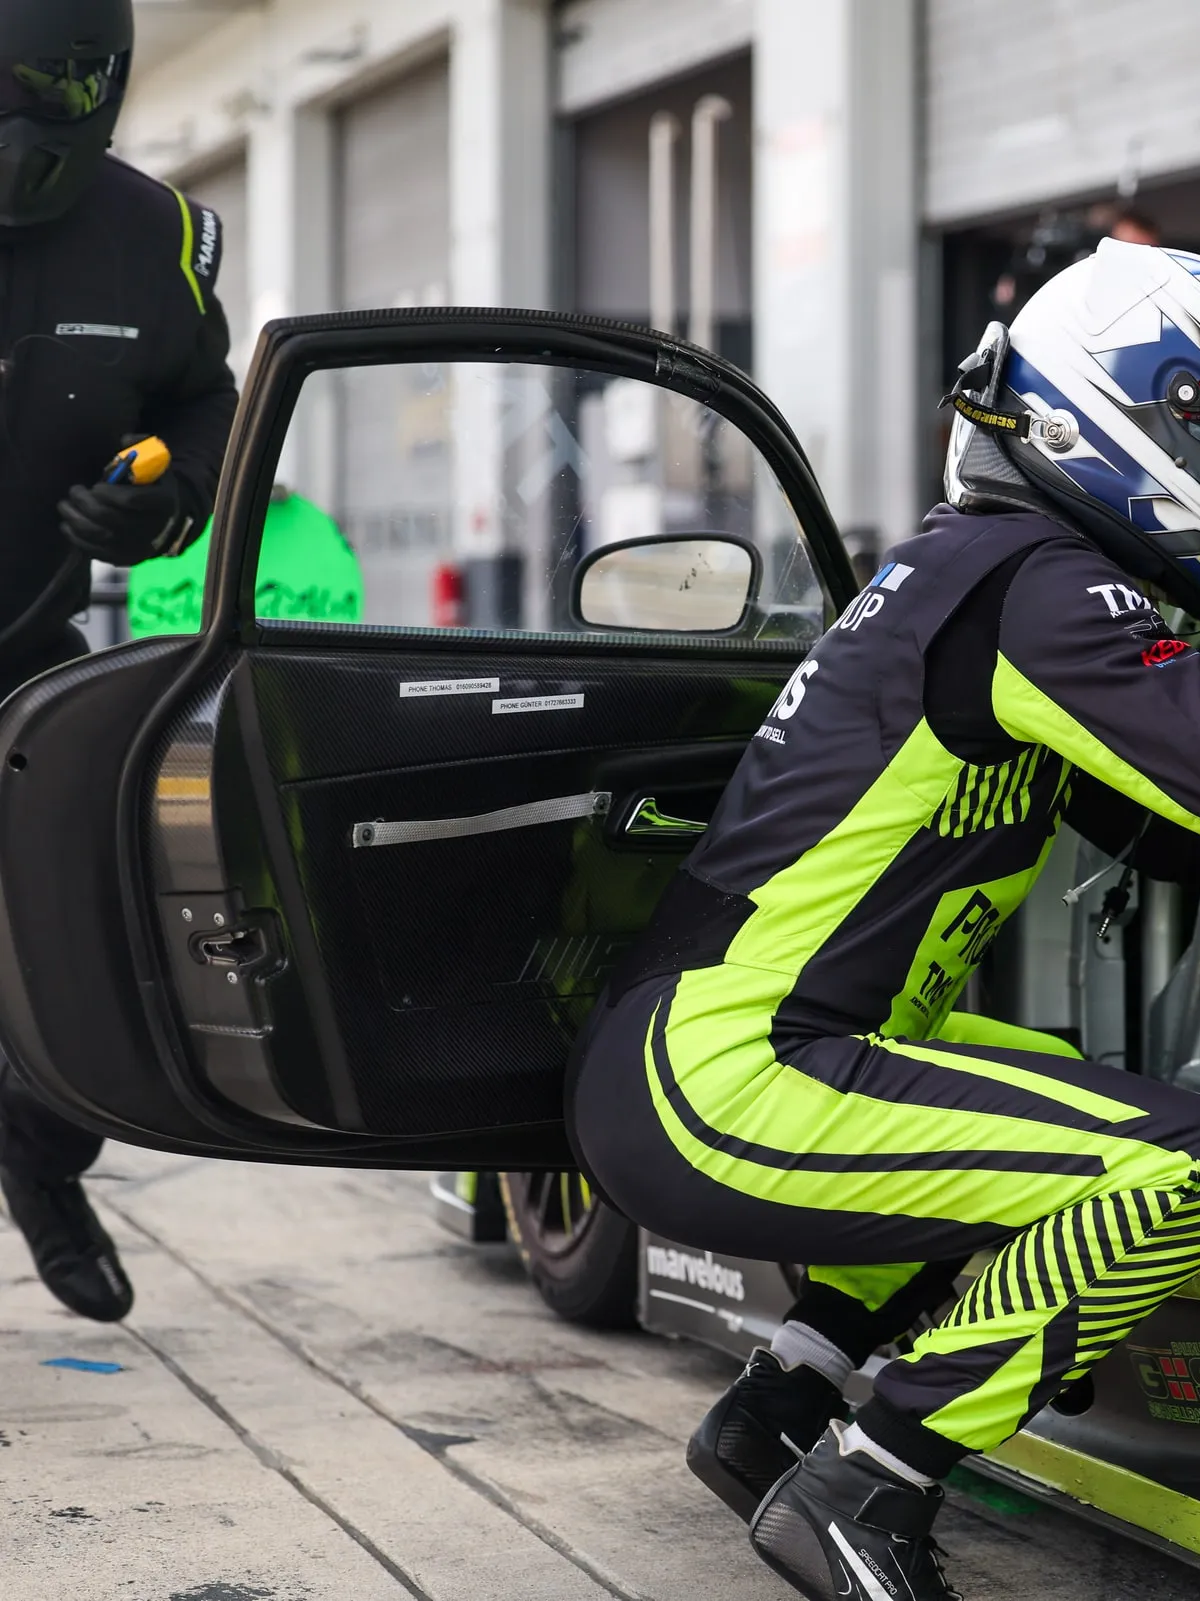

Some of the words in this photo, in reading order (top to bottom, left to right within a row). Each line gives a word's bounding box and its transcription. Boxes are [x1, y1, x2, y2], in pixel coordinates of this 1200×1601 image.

[408, 685, 428, 693] PHONE
[429, 684, 452, 692] THOMAS
[520, 700, 542, 709] GÜNTER
[647, 1245, 745, 1301] marvelous
[858, 1549, 889, 1583] SPEEDCAT
[884, 1580, 898, 1596] PRO
